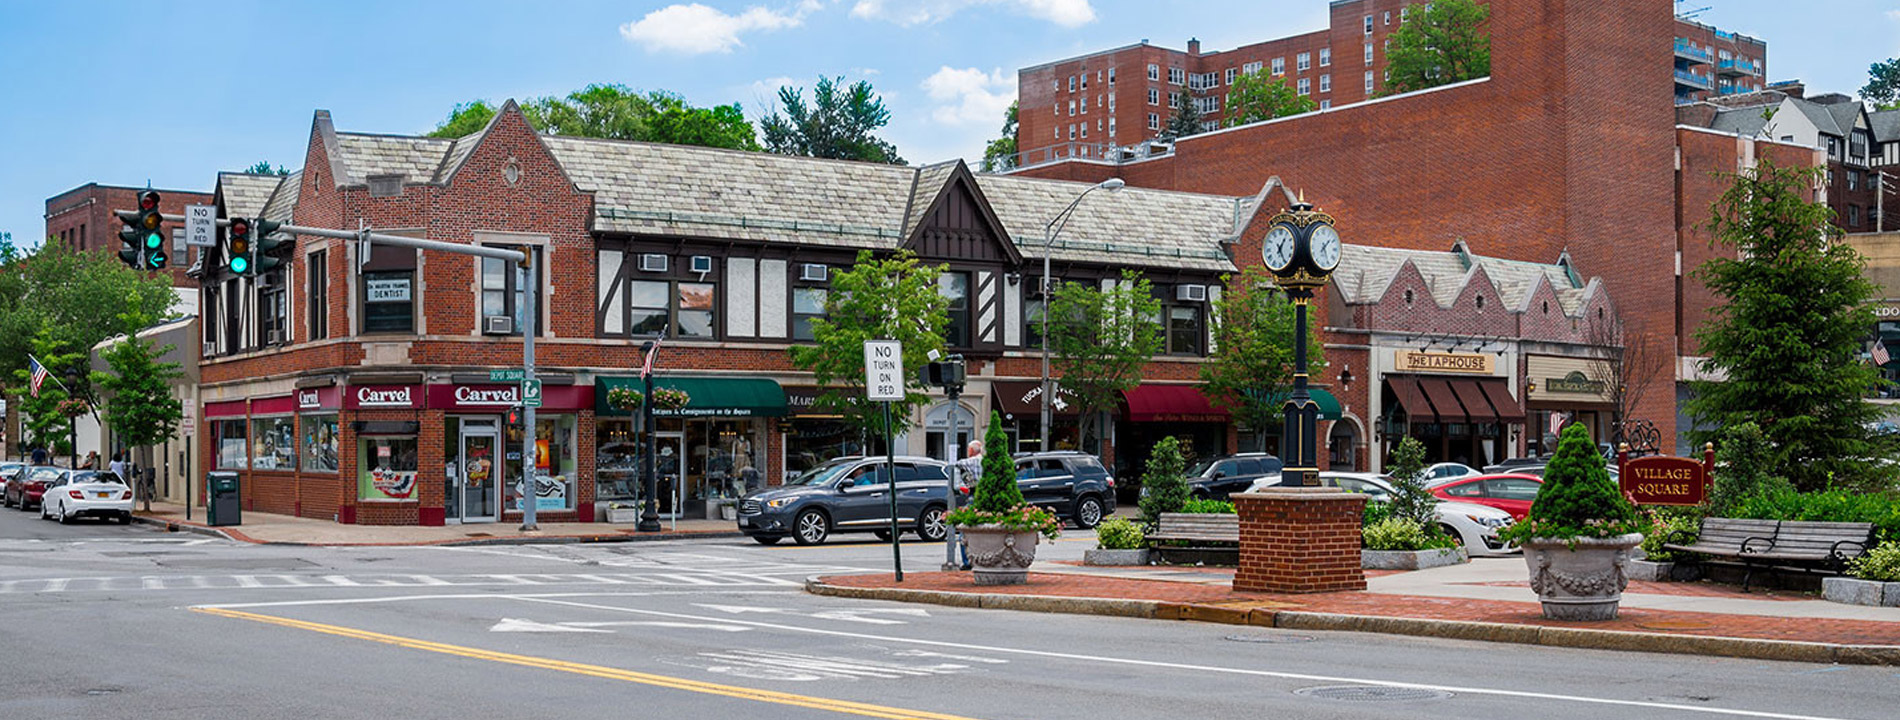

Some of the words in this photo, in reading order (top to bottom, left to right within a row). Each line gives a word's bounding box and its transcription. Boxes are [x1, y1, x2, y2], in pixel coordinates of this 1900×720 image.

[193, 208, 208, 217] NO
[192, 217, 210, 225] TURN
[195, 226, 206, 234] ON
[193, 234, 208, 242] RED
[875, 346, 892, 358] NO
[873, 360, 896, 370] TURN
[1407, 355, 1427, 365] THE
[1428, 356, 1486, 369] TAPHOUSE
[490, 370, 504, 380] DEPOT
[879, 372, 891, 382] ON
[357, 386, 411, 402] Carvel
[454, 386, 518, 401] Carvel
[877, 385, 895, 395] RED
[299, 388, 318, 404] Carvel
[1634, 468, 1692, 480] VILLAGE
[1637, 483, 1690, 496] SQUARE
